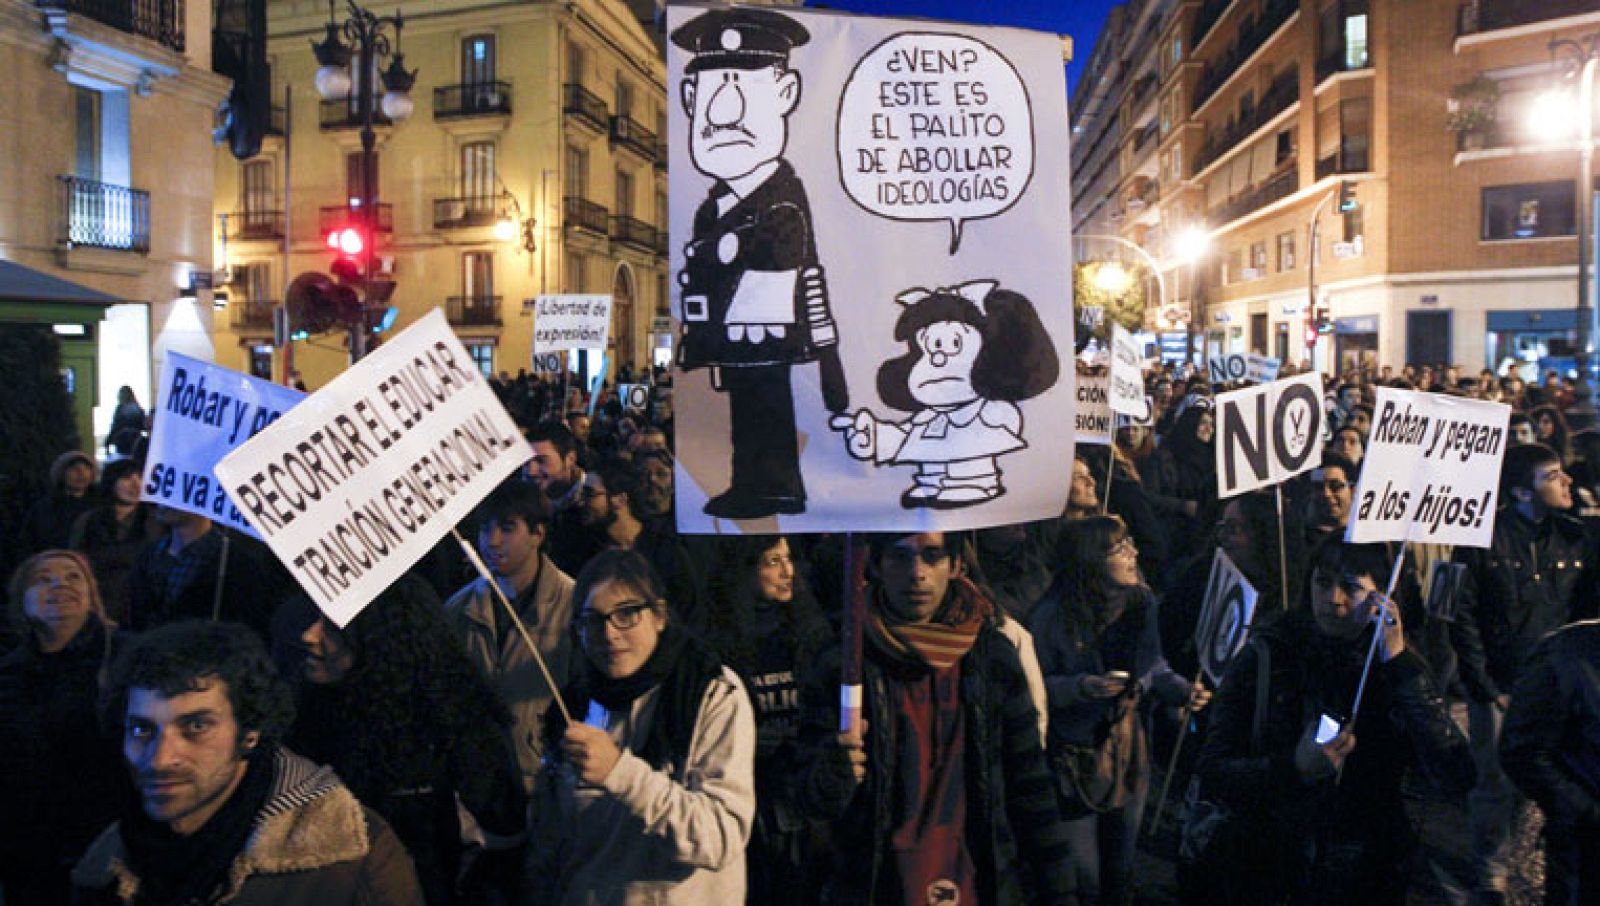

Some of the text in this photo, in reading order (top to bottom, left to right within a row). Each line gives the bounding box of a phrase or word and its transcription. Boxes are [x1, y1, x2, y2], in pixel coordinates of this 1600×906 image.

[887, 46, 978, 74] ¿VEN?
[879, 81, 988, 107] ESTE ES
[871, 113, 899, 140] EL
[857, 145, 1012, 173] DE ABOLLAR
[878, 174, 1009, 206] IDEOLOGÍAS
[592, 301, 607, 317] de
[533, 353, 559, 372] NO
[1210, 354, 1246, 381] NO
[167, 368, 231, 427] Robar
[228, 399, 248, 445] y
[1223, 383, 1321, 491] NO
[1374, 401, 1502, 462] Roban y pegan
[237, 413, 379, 537] RECORTAR
[354, 396, 402, 451] EL
[145, 463, 176, 498] se
[182, 471, 210, 508] va
[1358, 480, 1492, 535] a los hijos!
[293, 500, 404, 602] TRAICIÓN
